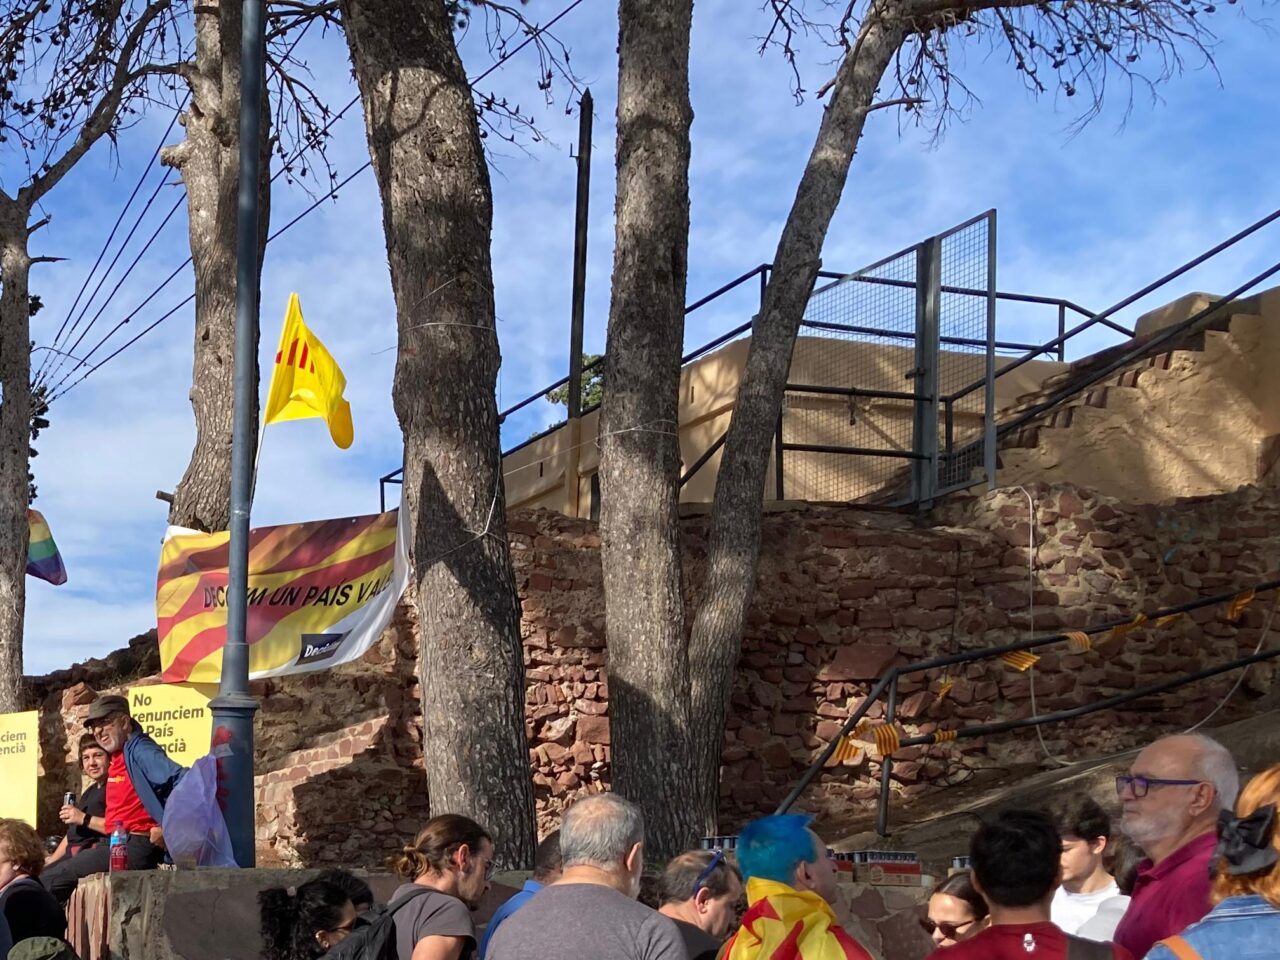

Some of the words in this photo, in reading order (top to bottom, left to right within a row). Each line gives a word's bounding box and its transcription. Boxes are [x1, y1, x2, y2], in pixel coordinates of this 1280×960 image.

[269, 586, 302, 606] UN
[302, 578, 353, 607] PAÍS
[133, 693, 152, 707] No
[132, 705, 204, 722] renunciem
[146, 723, 174, 738] País
